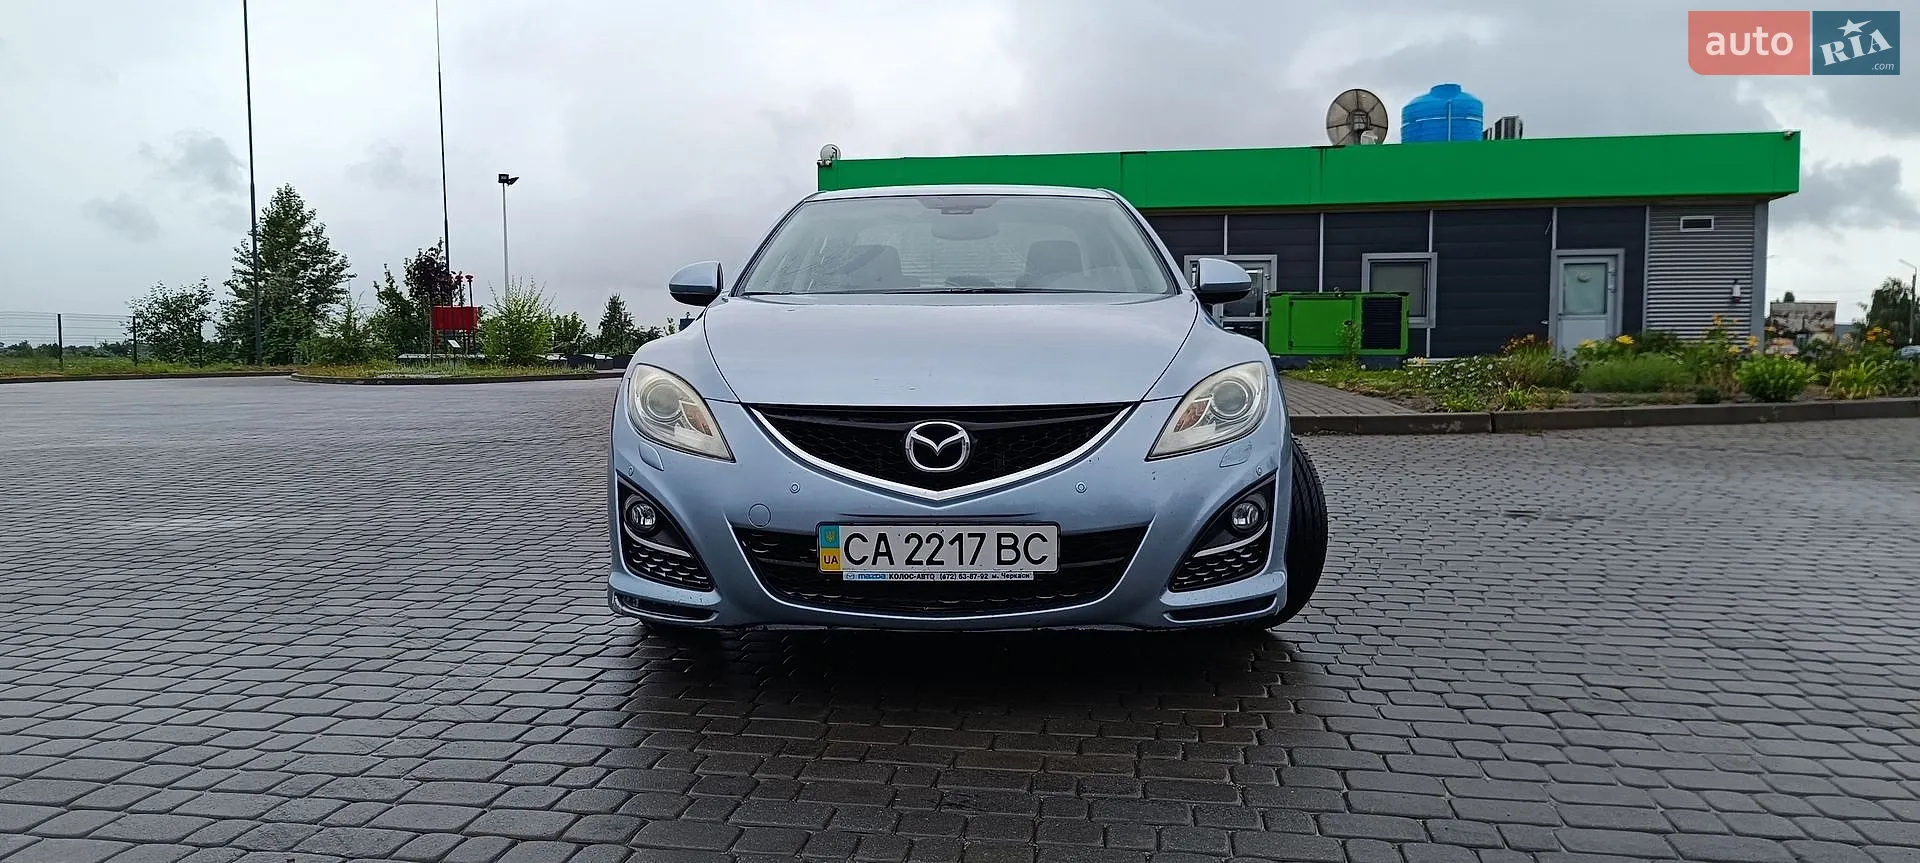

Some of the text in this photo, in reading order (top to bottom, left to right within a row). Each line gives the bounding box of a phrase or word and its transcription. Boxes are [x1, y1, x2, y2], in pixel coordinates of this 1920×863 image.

[843, 532, 1048, 565] CA 2217 BC
[823, 555, 839, 565] UA
